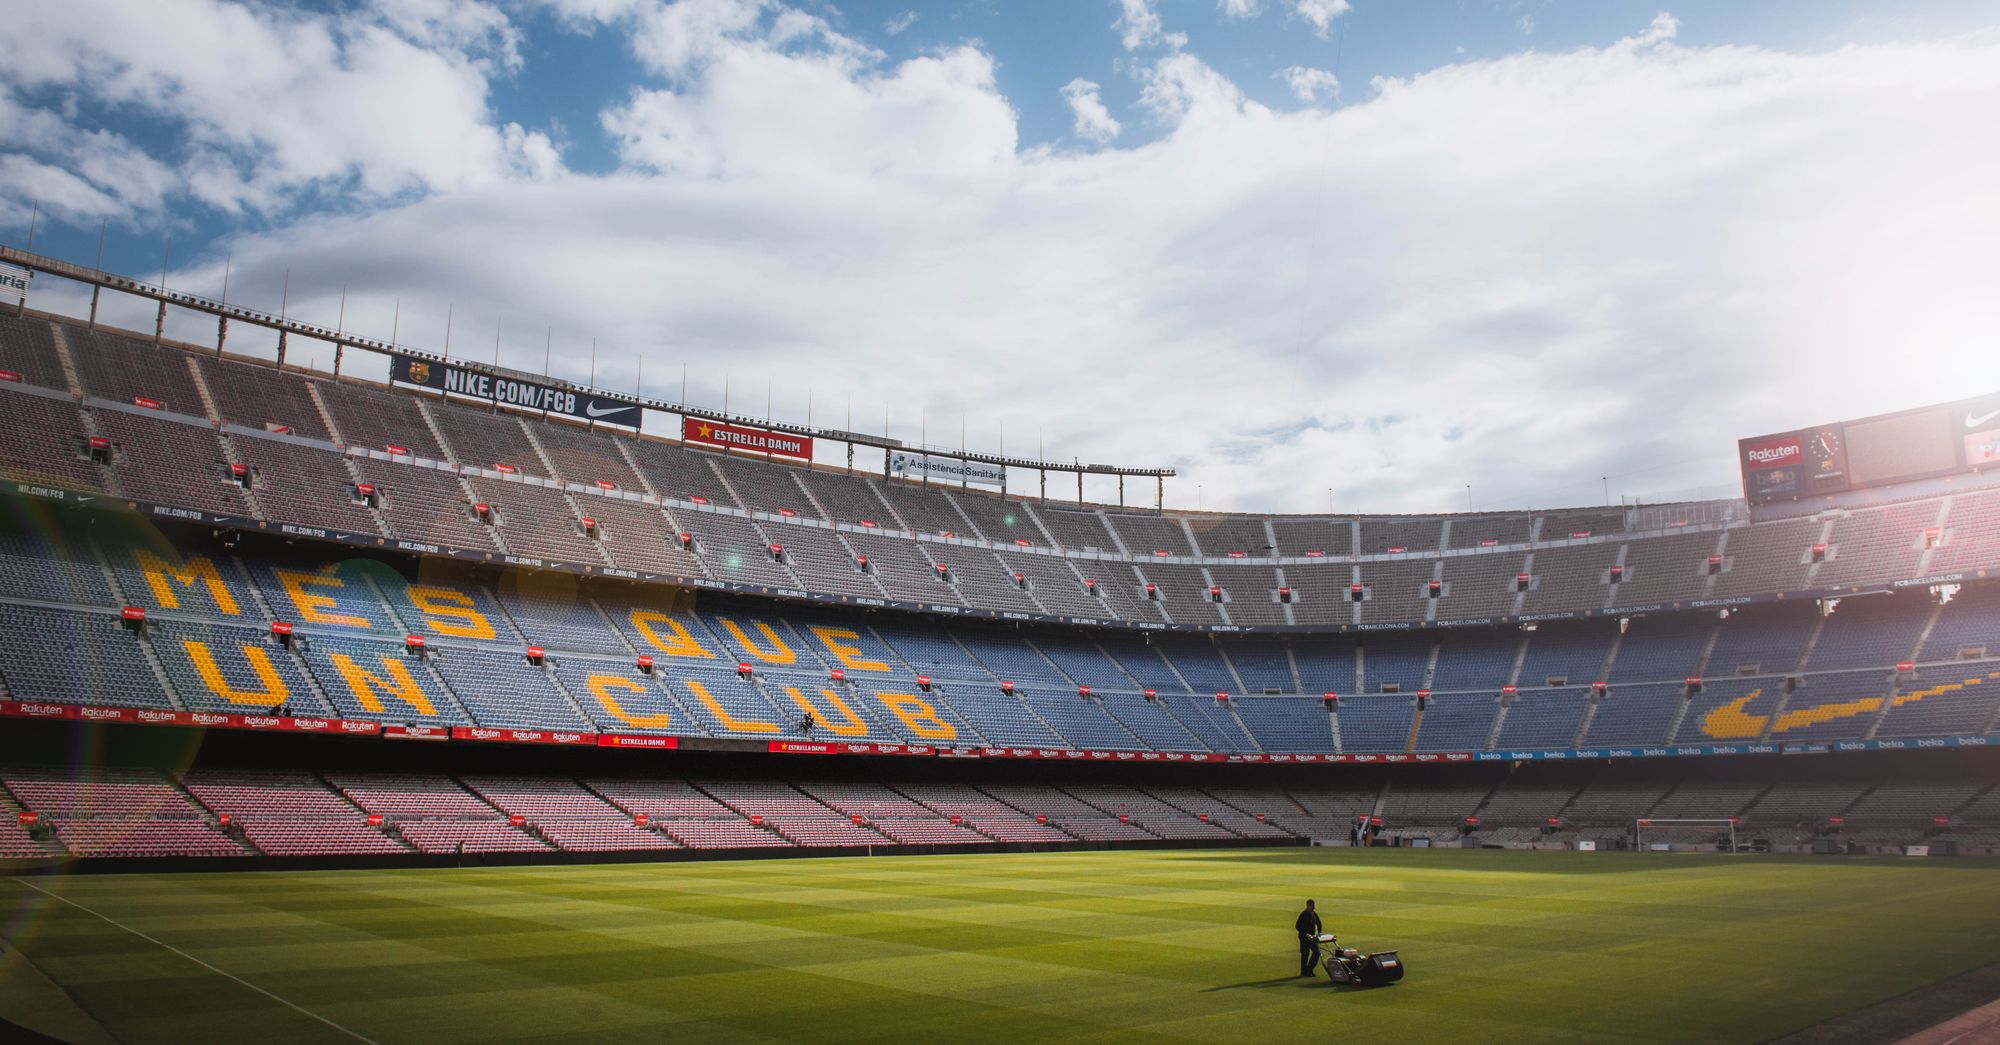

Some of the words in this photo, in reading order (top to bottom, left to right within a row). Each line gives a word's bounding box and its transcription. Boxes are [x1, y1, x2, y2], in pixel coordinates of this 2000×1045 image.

[0, 274, 25, 289] ria
[445, 368, 576, 414] NIKE.COM/FCB
[714, 430, 765, 447] ESTRELLA
[768, 439, 800, 453] DAMM
[1749, 445, 1799, 462] Rakuten
[154, 506, 202, 520] NIKE.COM/FCB
[282, 525, 326, 538] NIKE.COM/FCB
[398, 541, 438, 553] NIKE.COM/FCB
[505, 555, 542, 567] NIKE.COM/FCB
[630, 609, 893, 671] QUE
[183, 640, 438, 716] UN
[587, 674, 958, 740] CLUB
[21, 703, 62, 715] Rakuten
[81, 707, 121, 719] Rakuten
[138, 711, 176, 722] Rakuten
[192, 713, 228, 724] Rakuten
[245, 716, 280, 727] Rakuten
[294, 719, 328, 730] Rakuten
[342, 721, 374, 732] Rakuten
[406, 726, 431, 736] Rakuten
[471, 728, 500, 739] Rakuten
[512, 731, 541, 741] Rakuten
[553, 733, 580, 743] Rakuten
[848, 744, 869, 753] Rakuten
[878, 744, 899, 753] Rakuten
[907, 745, 928, 754] Rakuten
[1840, 742, 1865, 750] beko
[1918, 739, 1944, 747] beko
[1958, 737, 1986, 745] beko
[1544, 751, 1565, 759] beko
[1577, 750, 1598, 758] beko
[1713, 746, 1736, 754] beko
[1748, 745, 1773, 753] beko
